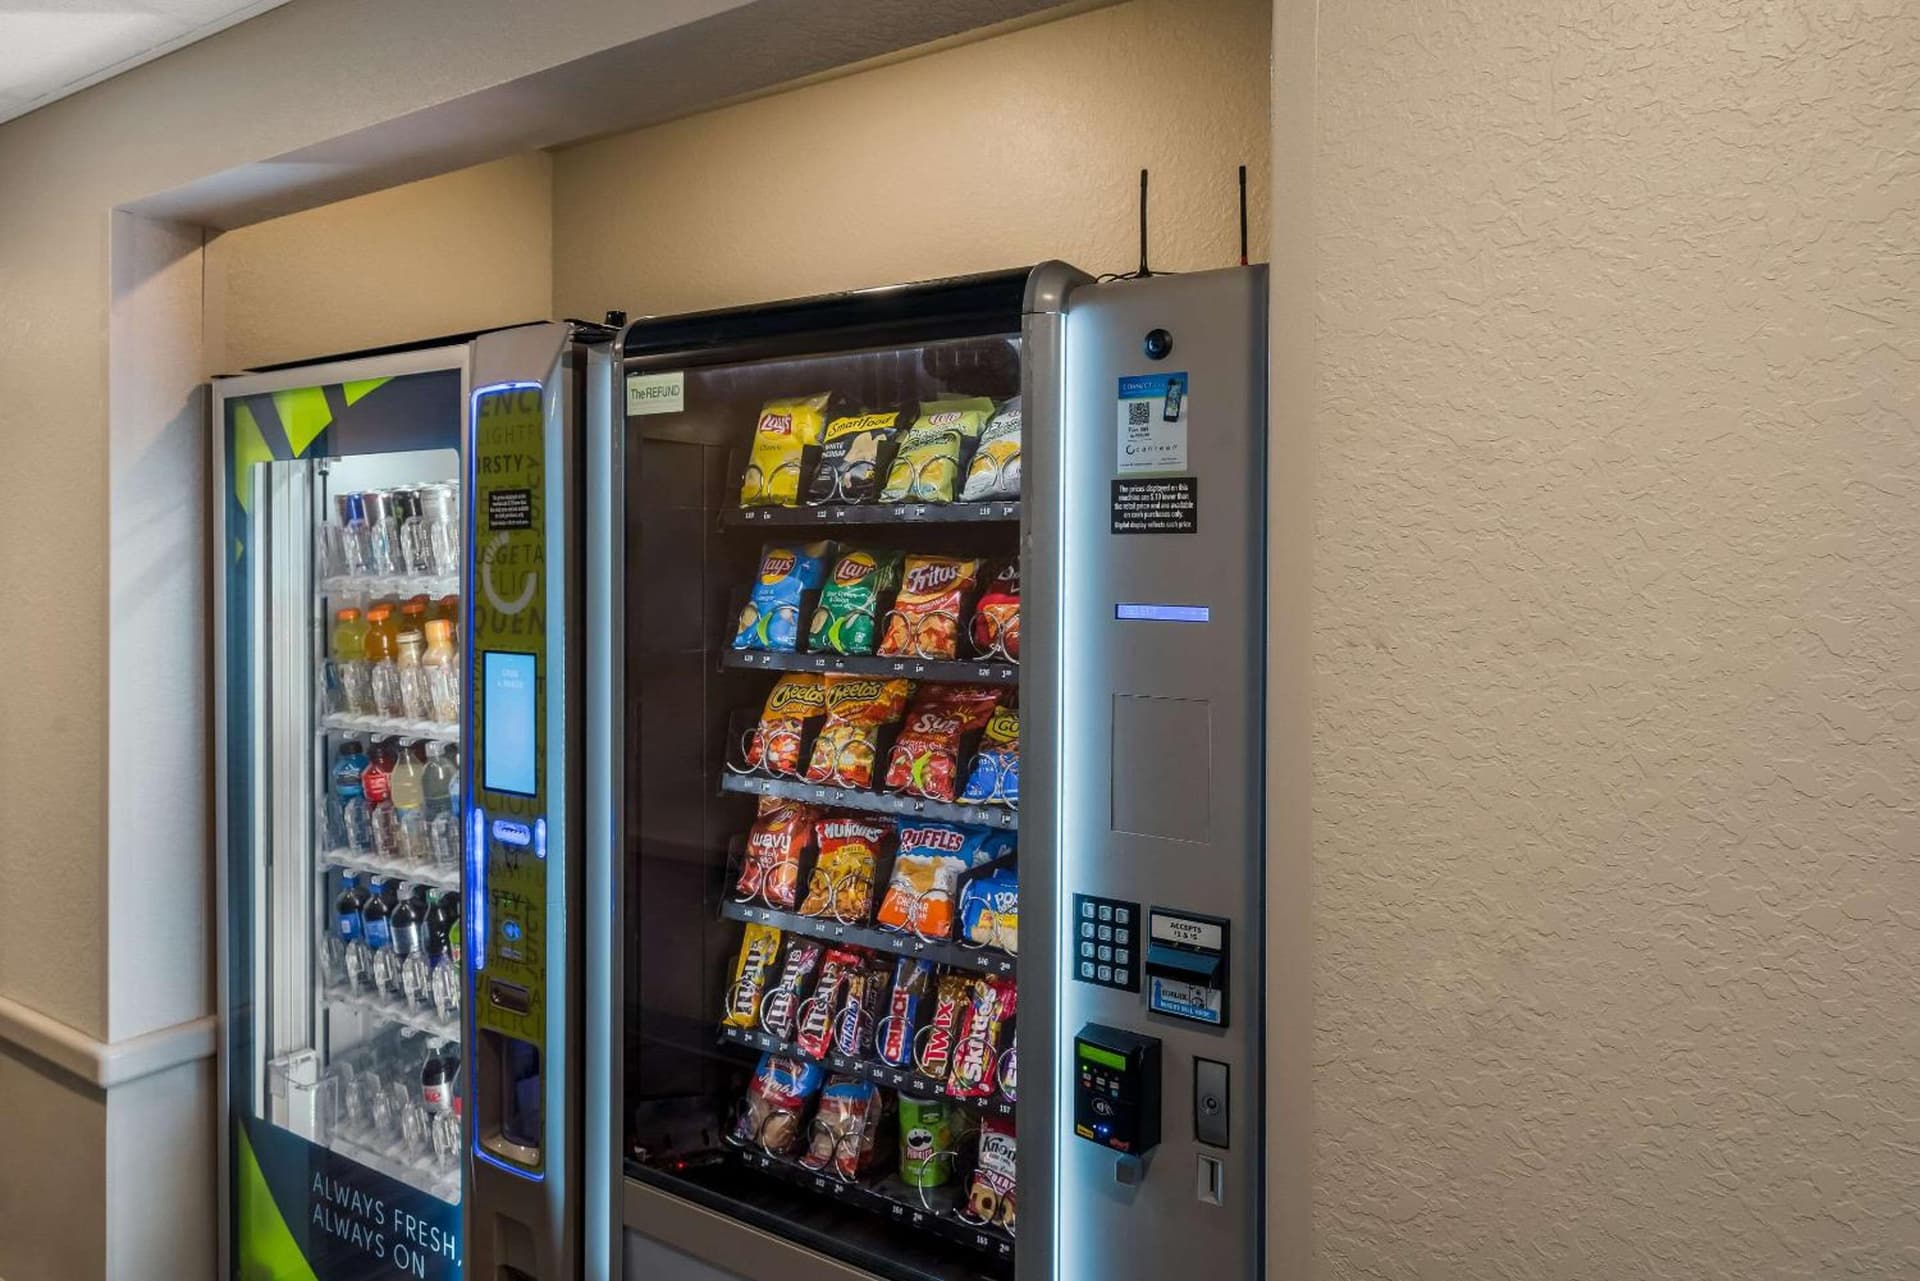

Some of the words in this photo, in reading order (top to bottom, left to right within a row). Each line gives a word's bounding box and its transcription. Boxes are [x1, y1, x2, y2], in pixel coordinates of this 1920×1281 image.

[828, 411, 896, 437] Smartfood
[908, 564, 959, 593] Fritos
[772, 683, 825, 707] Cheetos
[828, 681, 880, 707] Cheetos
[900, 828, 964, 852] RUFFLES
[1170, 922, 1202, 934] ACCEPTS
[922, 999, 954, 1066] TWIX
[313, 1171, 385, 1225] ALWAYS
[394, 1209, 462, 1266] FRESH,
[313, 1203, 385, 1258] ALWAYS
[393, 1243, 425, 1280] ON
